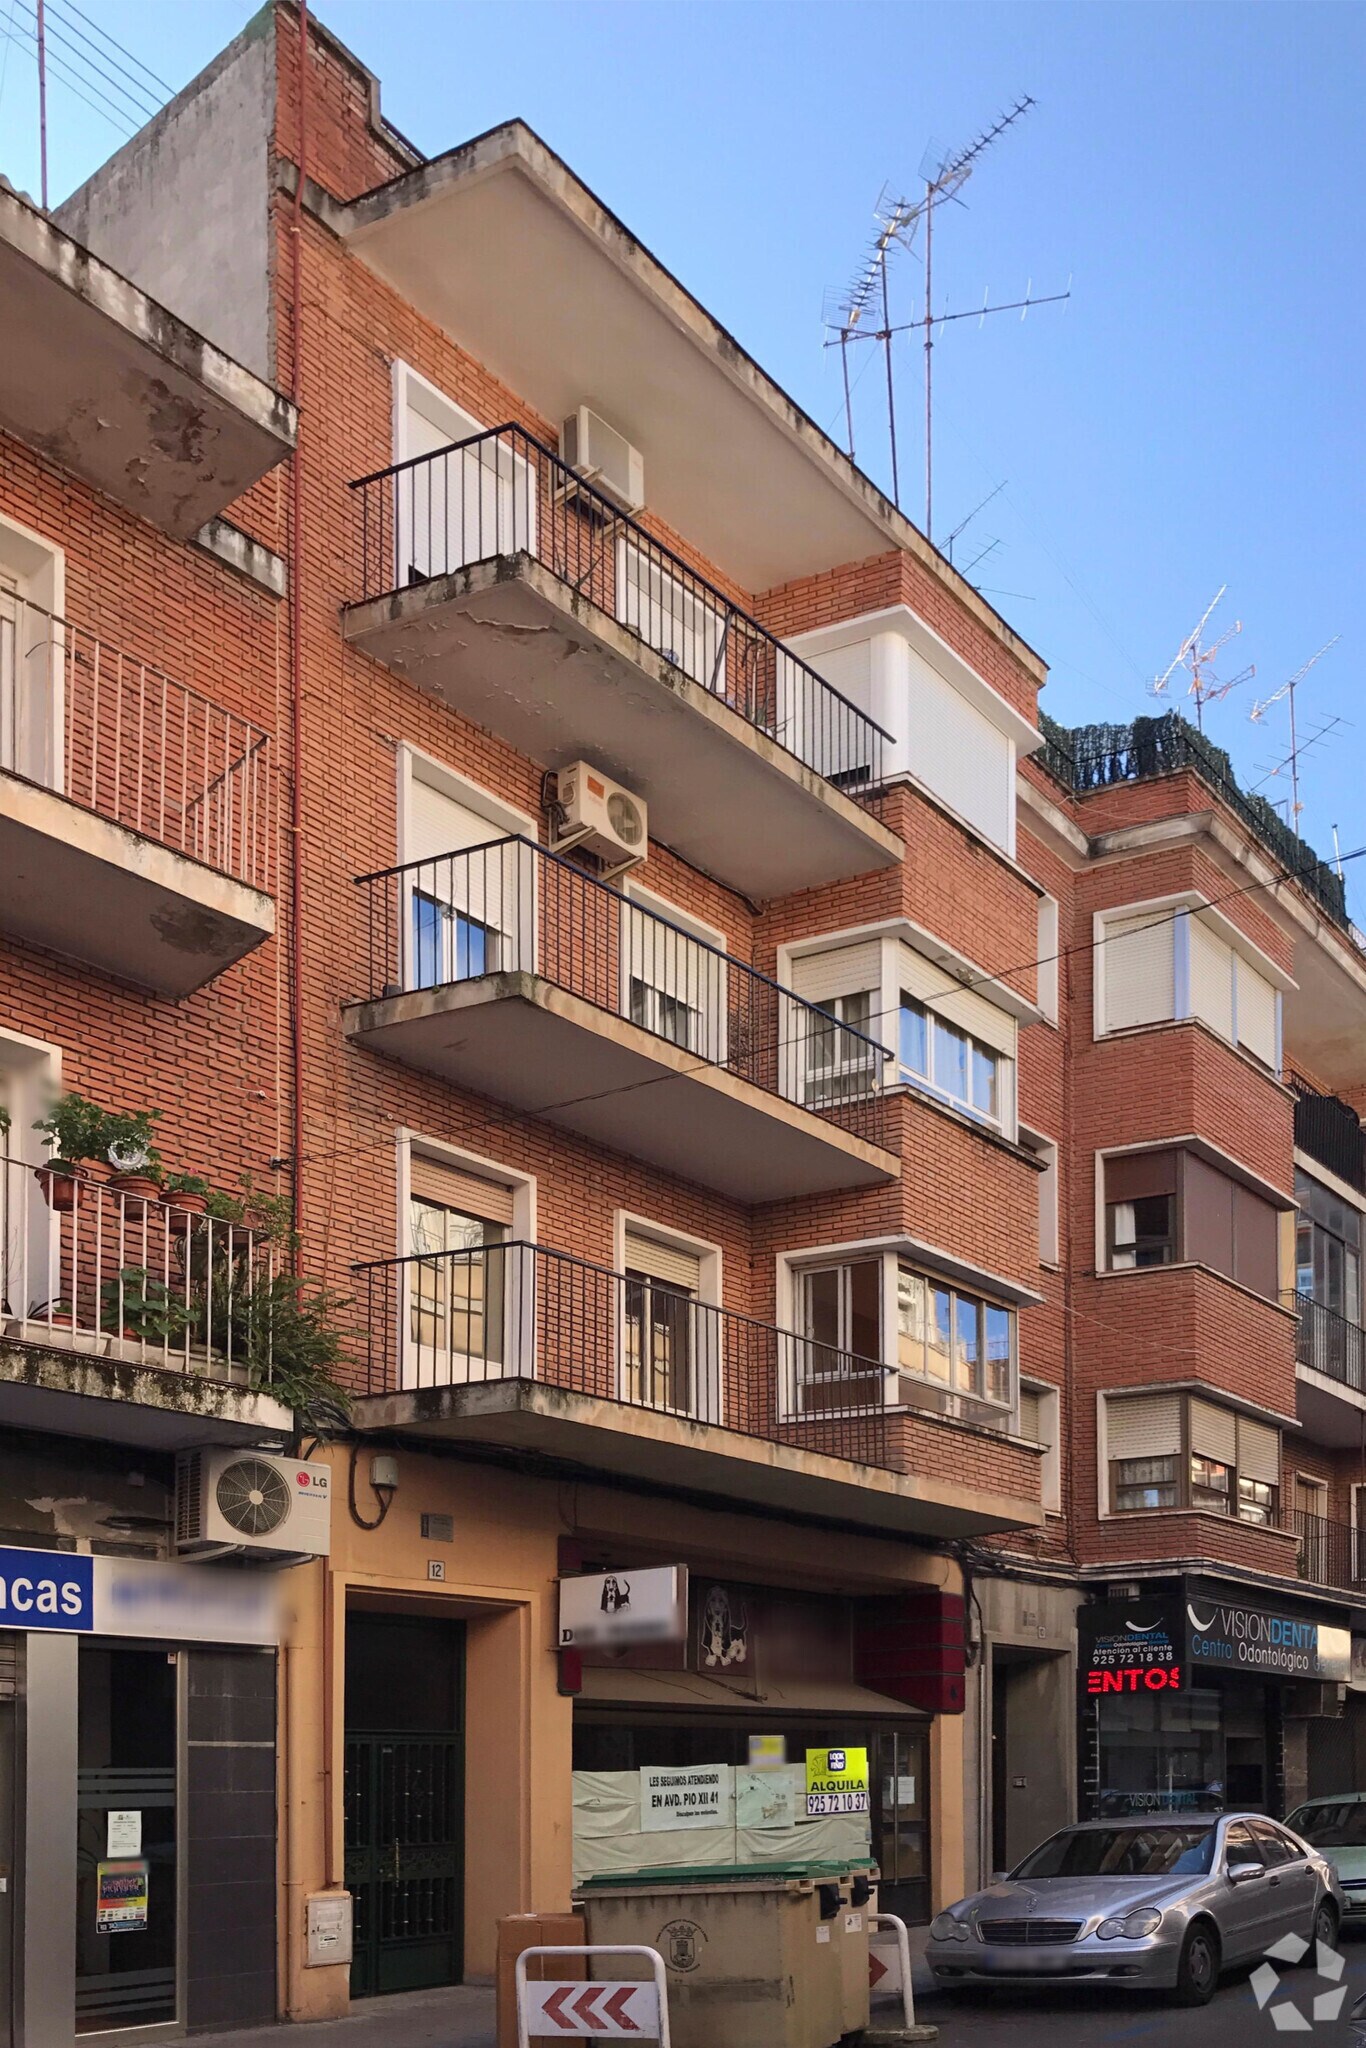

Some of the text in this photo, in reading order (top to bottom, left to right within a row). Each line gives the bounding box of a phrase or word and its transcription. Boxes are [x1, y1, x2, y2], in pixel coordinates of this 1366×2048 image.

[312, 1476, 328, 1488] LG
[432, 1564, 442, 1578] 12
[1221, 1609, 1318, 1650] VISIONDENTA
[1095, 1632, 1169, 1643] VISIONDENTAL
[1143, 1644, 1173, 1652] cliente
[1191, 1634, 1233, 1660] Centro
[1238, 1641, 1309, 1672] Odontológico
[1092, 1652, 1173, 1665] 925 72 18 38
[829, 1752, 844, 1760] LOOK
[649, 1774, 719, 1787] LES SEGUIMOS ATENDIENDO
[811, 1780, 864, 1792] ALQUILA
[651, 1791, 719, 1807] EN AVD. PIO XII 41
[809, 1793, 866, 1812] 925 72 10 37
